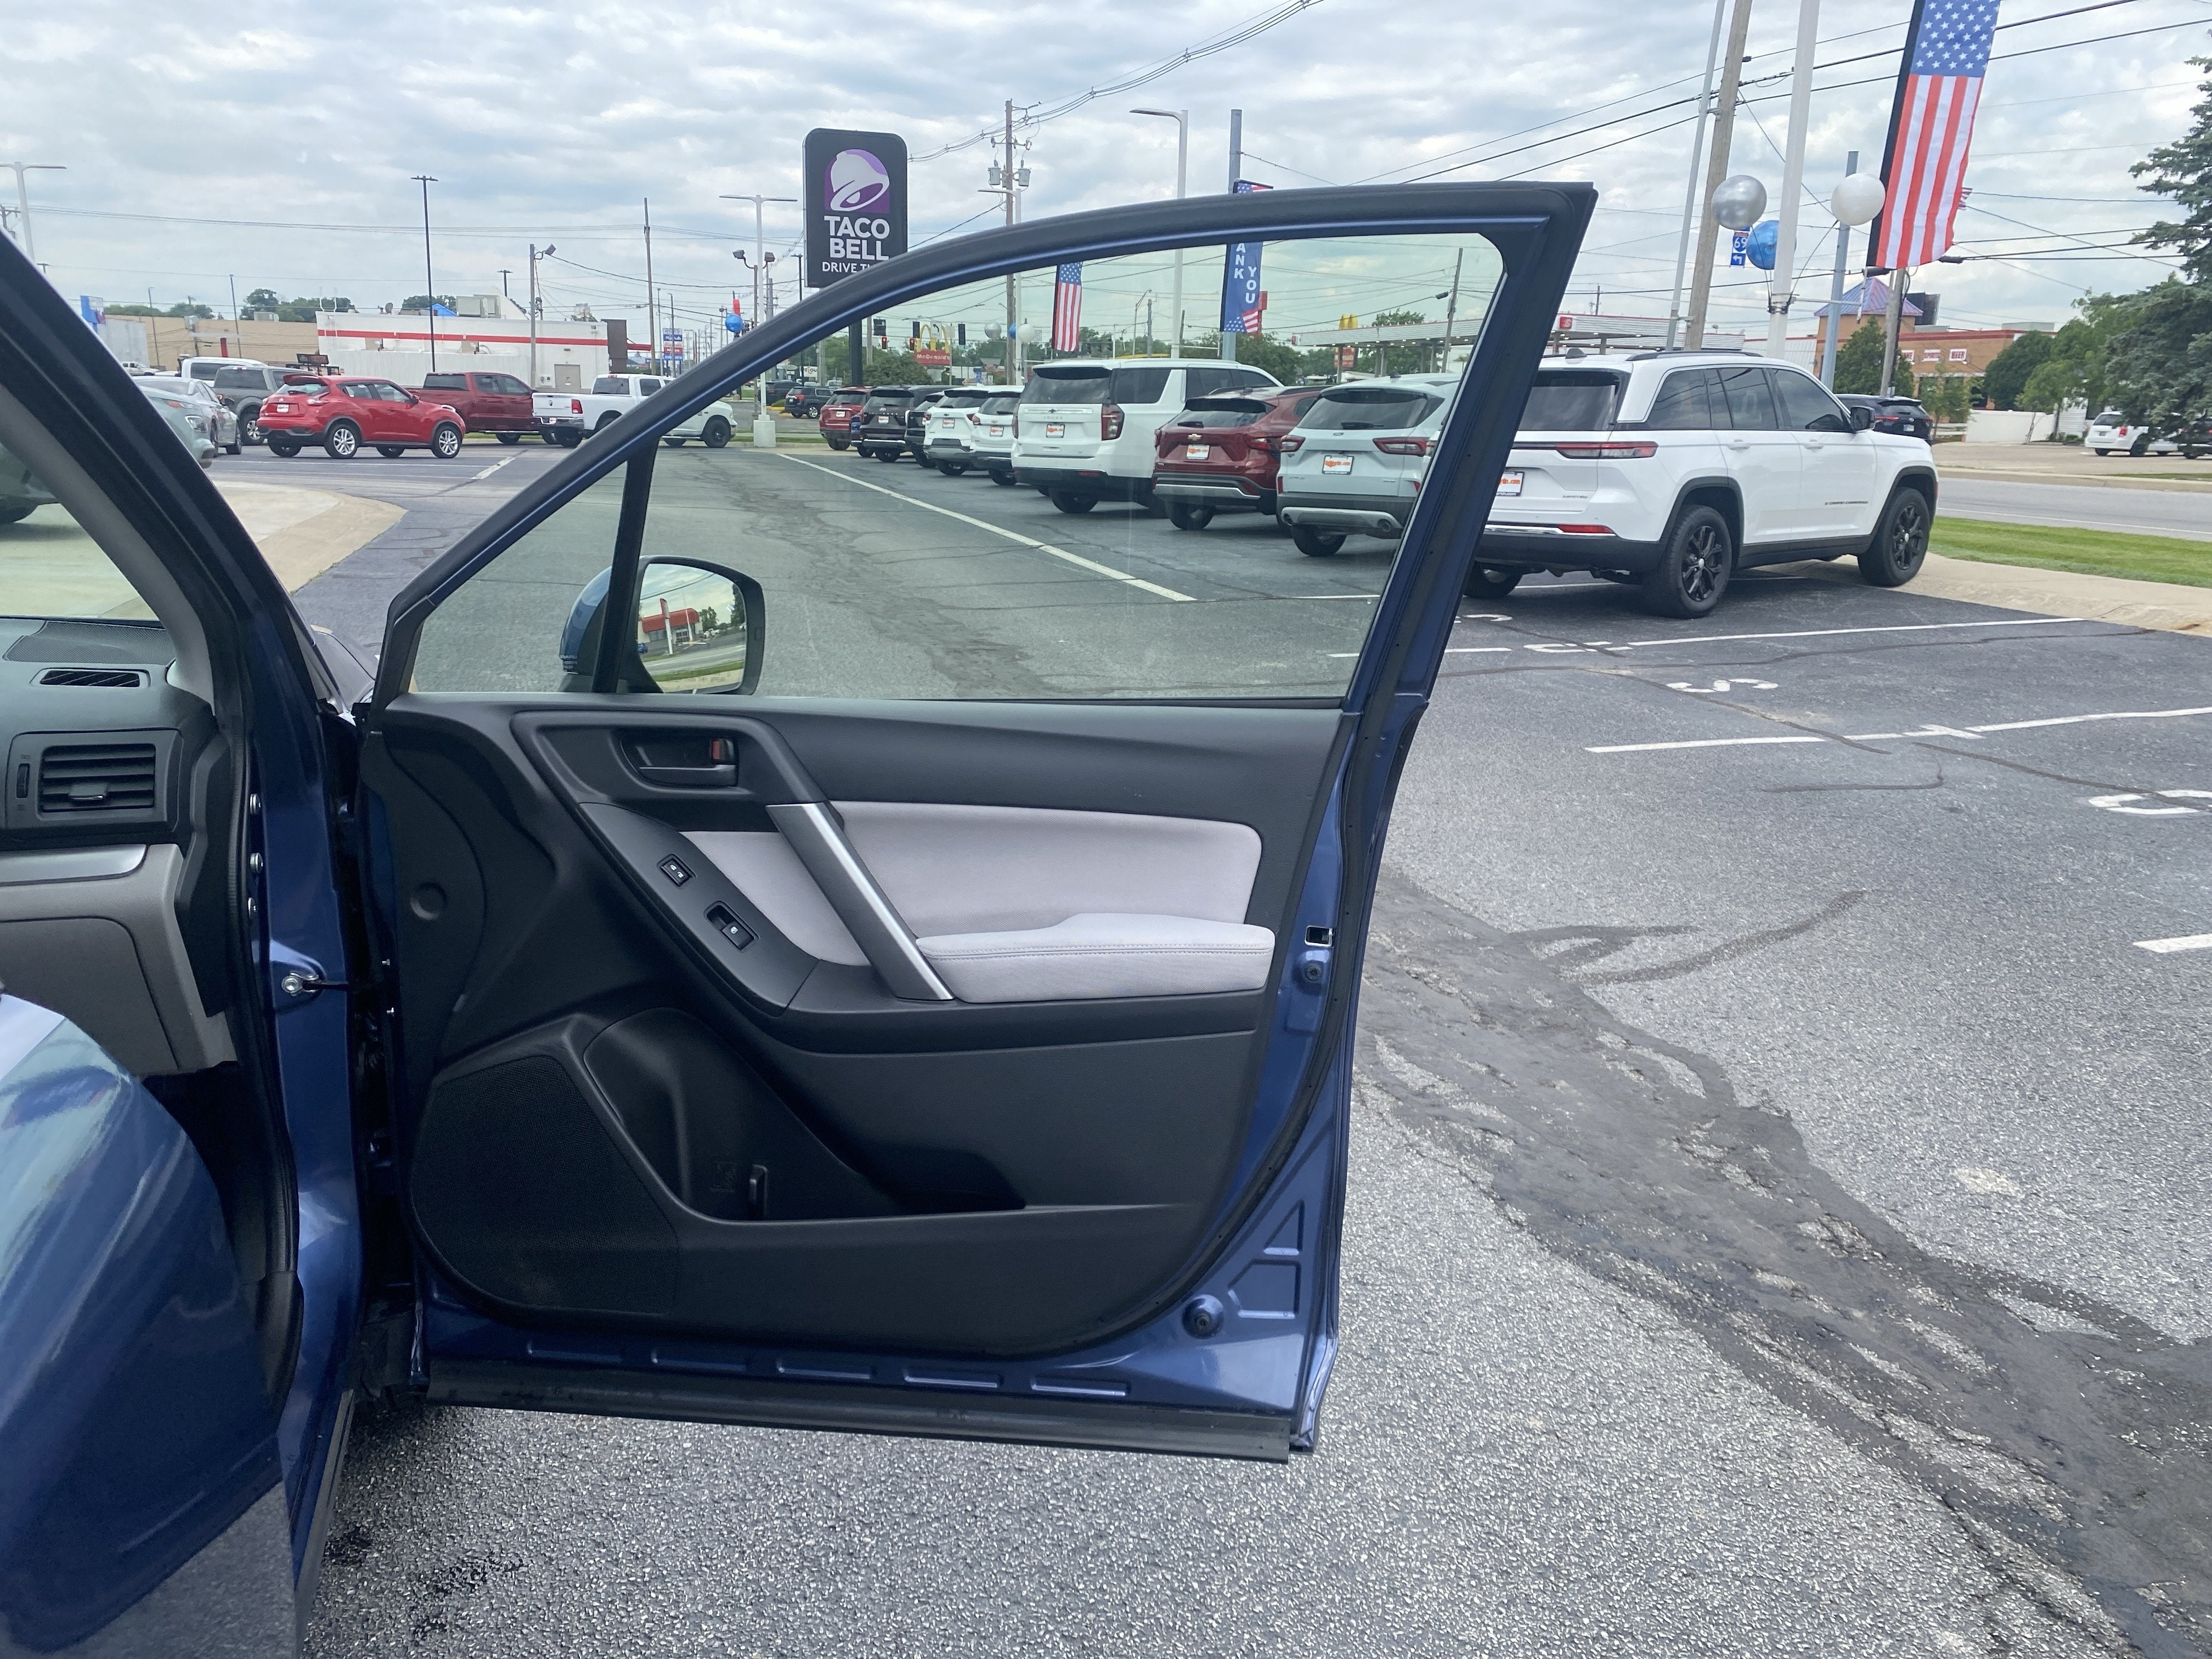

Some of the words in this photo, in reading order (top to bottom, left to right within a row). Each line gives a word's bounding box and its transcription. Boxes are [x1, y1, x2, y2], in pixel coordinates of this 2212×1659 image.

[824, 216, 890, 239] TACO
[830, 238, 889, 261] BELL
[1734, 237, 1747, 249] 69
[822, 262, 857, 273] DRIVE
[1245, 266, 1257, 304] YOU
